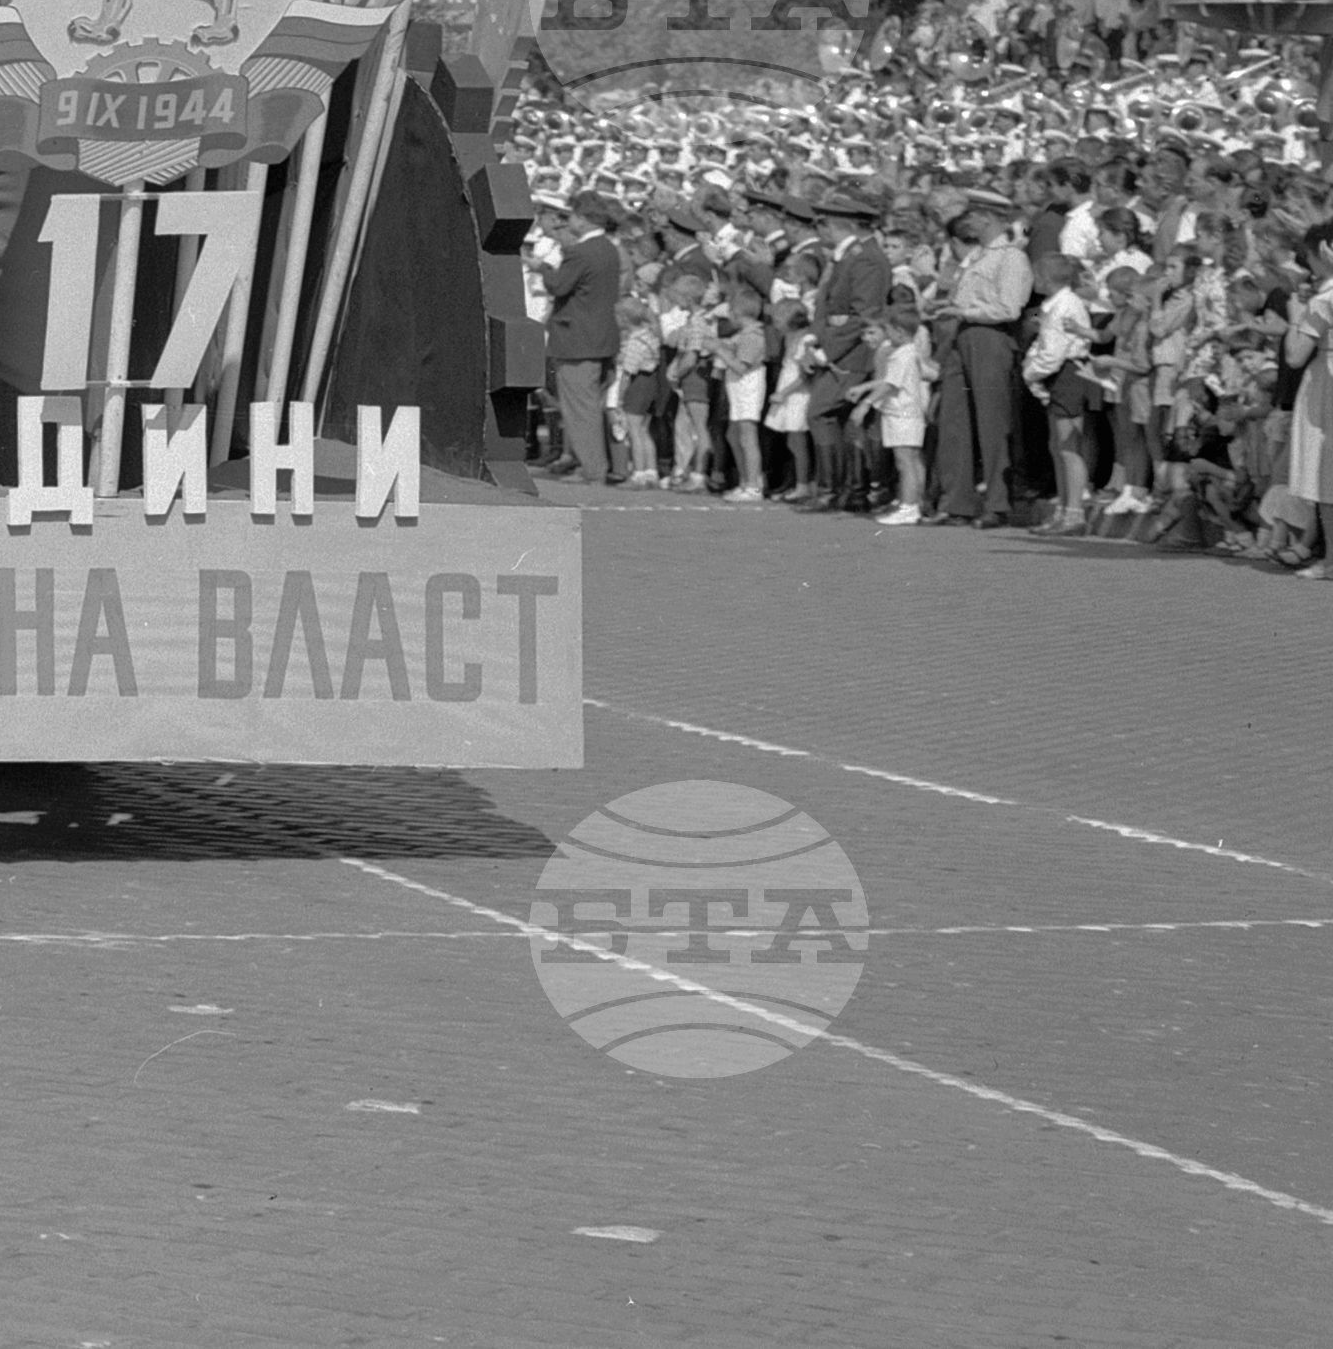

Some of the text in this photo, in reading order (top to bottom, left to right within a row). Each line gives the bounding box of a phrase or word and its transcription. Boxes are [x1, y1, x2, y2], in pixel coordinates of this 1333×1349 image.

[56, 88, 235, 130] 9 IX 1944
[37, 191, 261, 390] 17
[196, 568, 559, 706] ВЛАСТ
